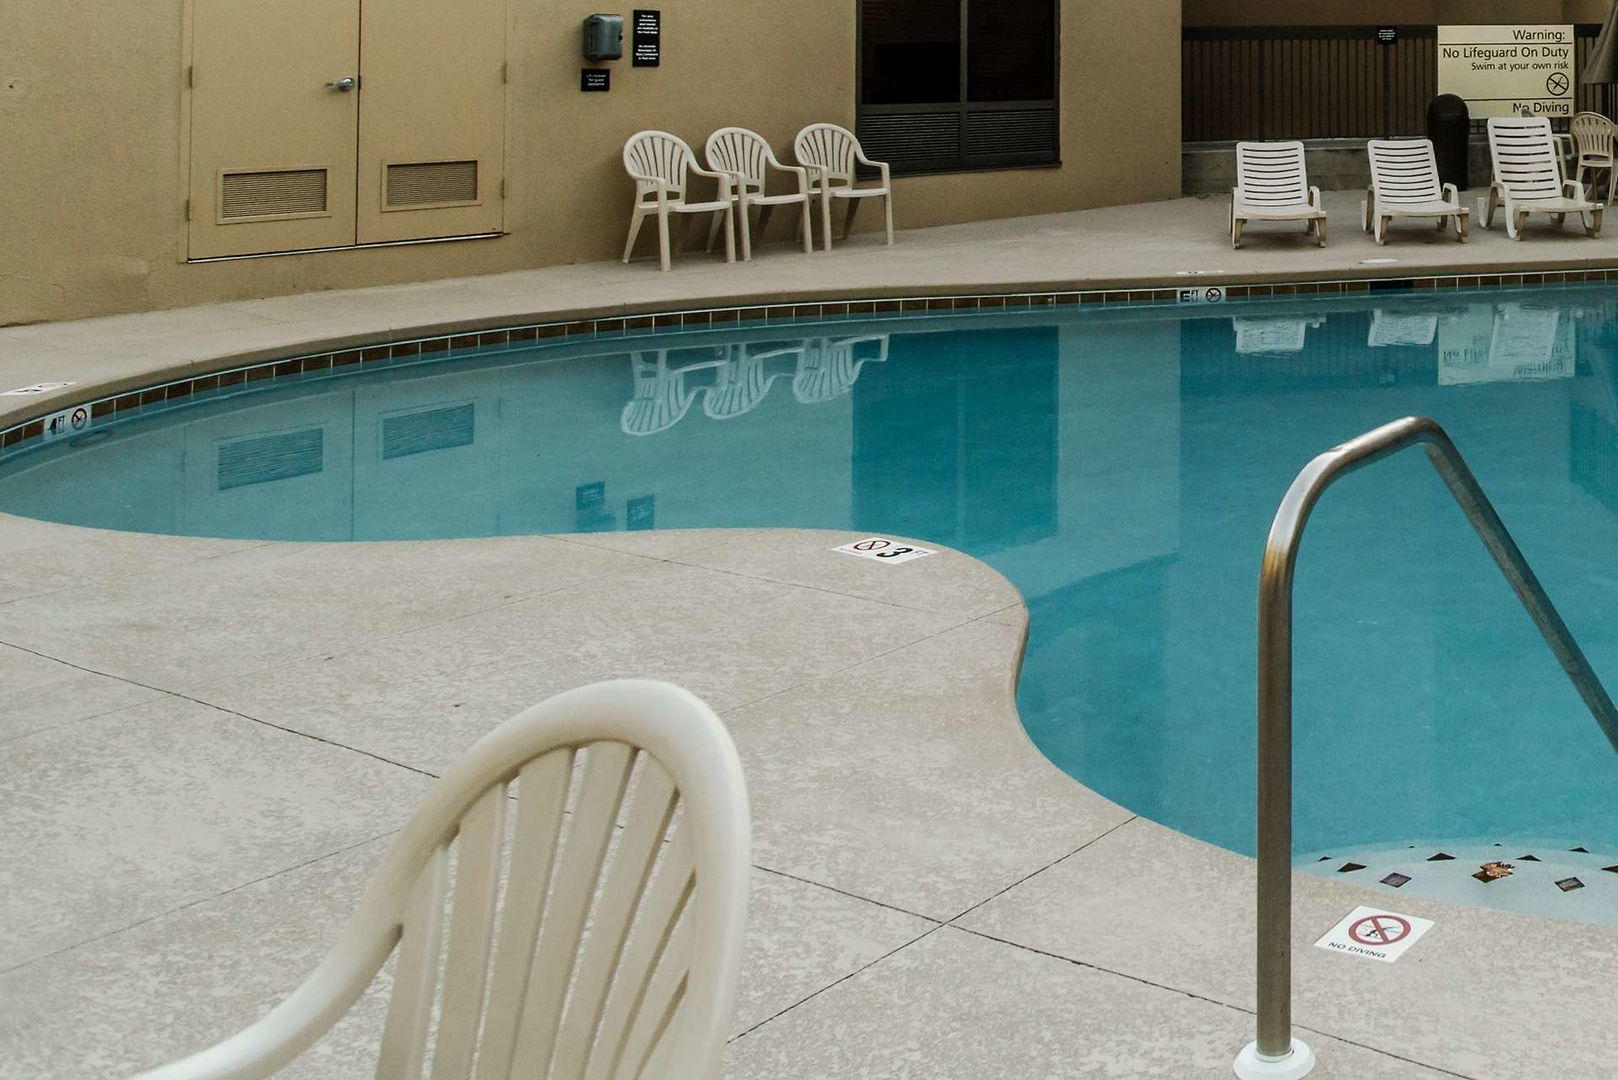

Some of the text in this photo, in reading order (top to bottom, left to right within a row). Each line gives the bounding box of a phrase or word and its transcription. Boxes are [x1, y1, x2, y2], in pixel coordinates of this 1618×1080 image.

[1513, 29, 1566, 42] Warning:
[1443, 47, 1569, 61] No Lifeguard On Duty
[1471, 62, 1496, 71] Swim
[1498, 63, 1507, 71] at
[1510, 63, 1530, 72] your
[1554, 61, 1569, 70] risk
[1512, 102, 1570, 115] No Diving
[1348, 945, 1387, 959] DIVING
